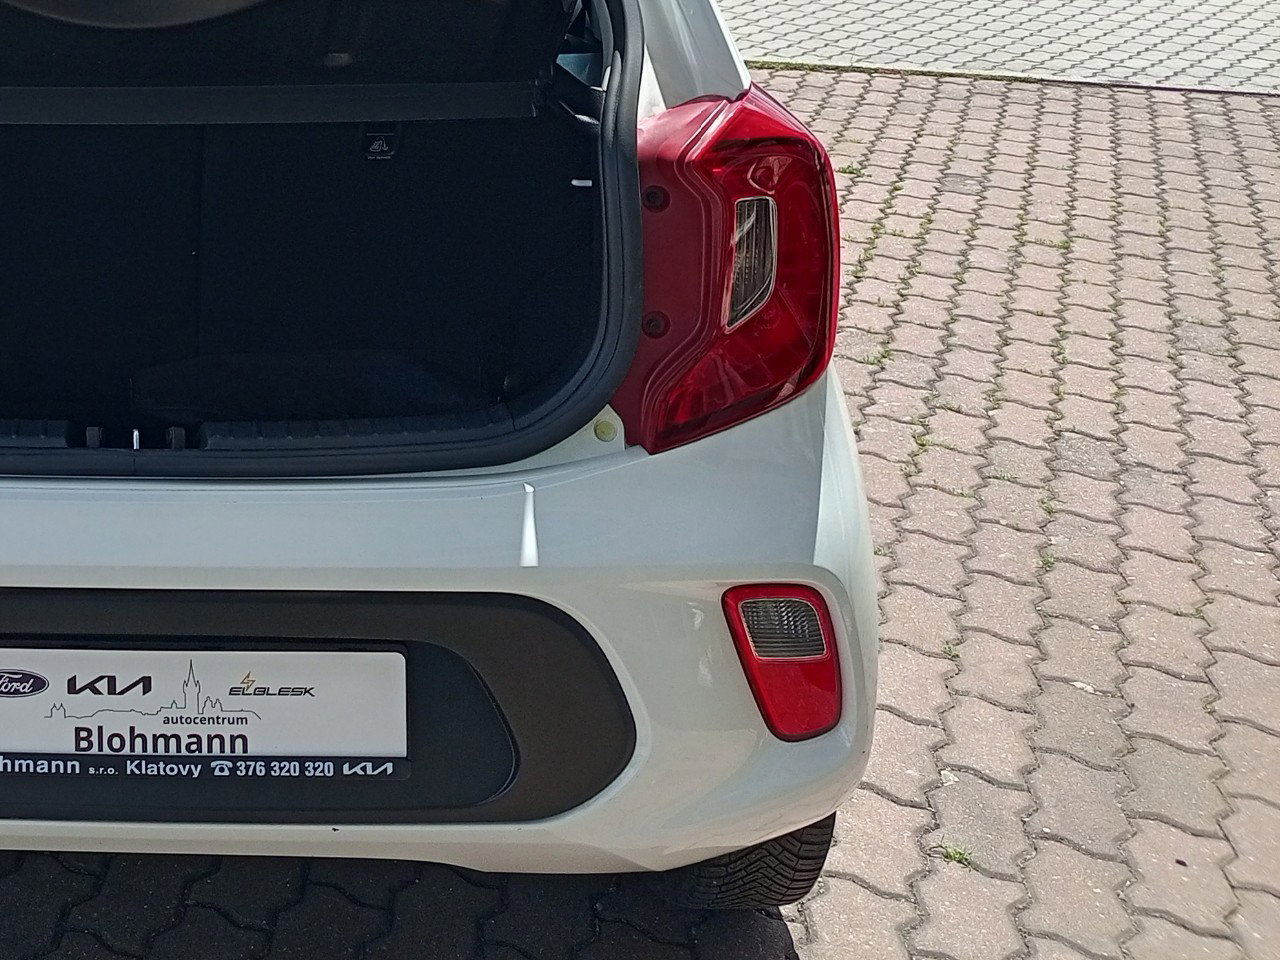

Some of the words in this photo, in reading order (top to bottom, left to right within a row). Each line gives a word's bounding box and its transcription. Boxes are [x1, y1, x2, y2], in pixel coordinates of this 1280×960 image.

[67, 674, 153, 696] KIA
[228, 686, 316, 697] ELBLESK
[162, 715, 249, 726] autocentrum
[74, 725, 249, 754] Blohmann
[88, 766, 119, 775] s.r.o.
[126, 759, 202, 778] Klatovy
[236, 761, 266, 776] 376
[270, 762, 300, 777] 320
[304, 761, 334, 777] 320
